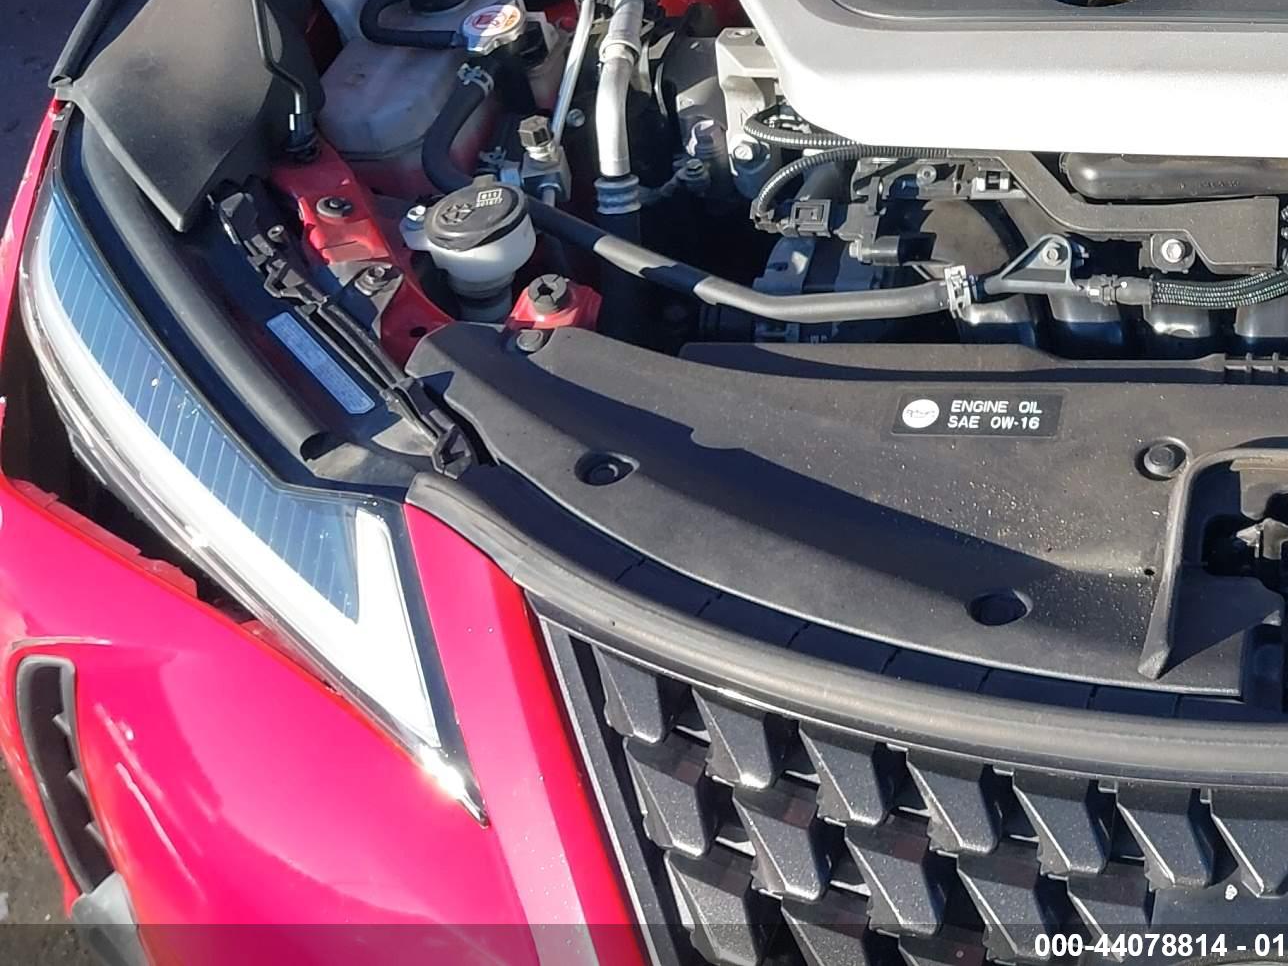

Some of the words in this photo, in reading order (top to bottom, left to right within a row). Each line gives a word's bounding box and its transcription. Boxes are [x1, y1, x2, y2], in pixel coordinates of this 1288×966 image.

[951, 400, 1009, 413] ENGINE
[1018, 401, 1042, 414] OIL
[947, 416, 980, 428] SAE
[990, 417, 1040, 429] 0W-16
